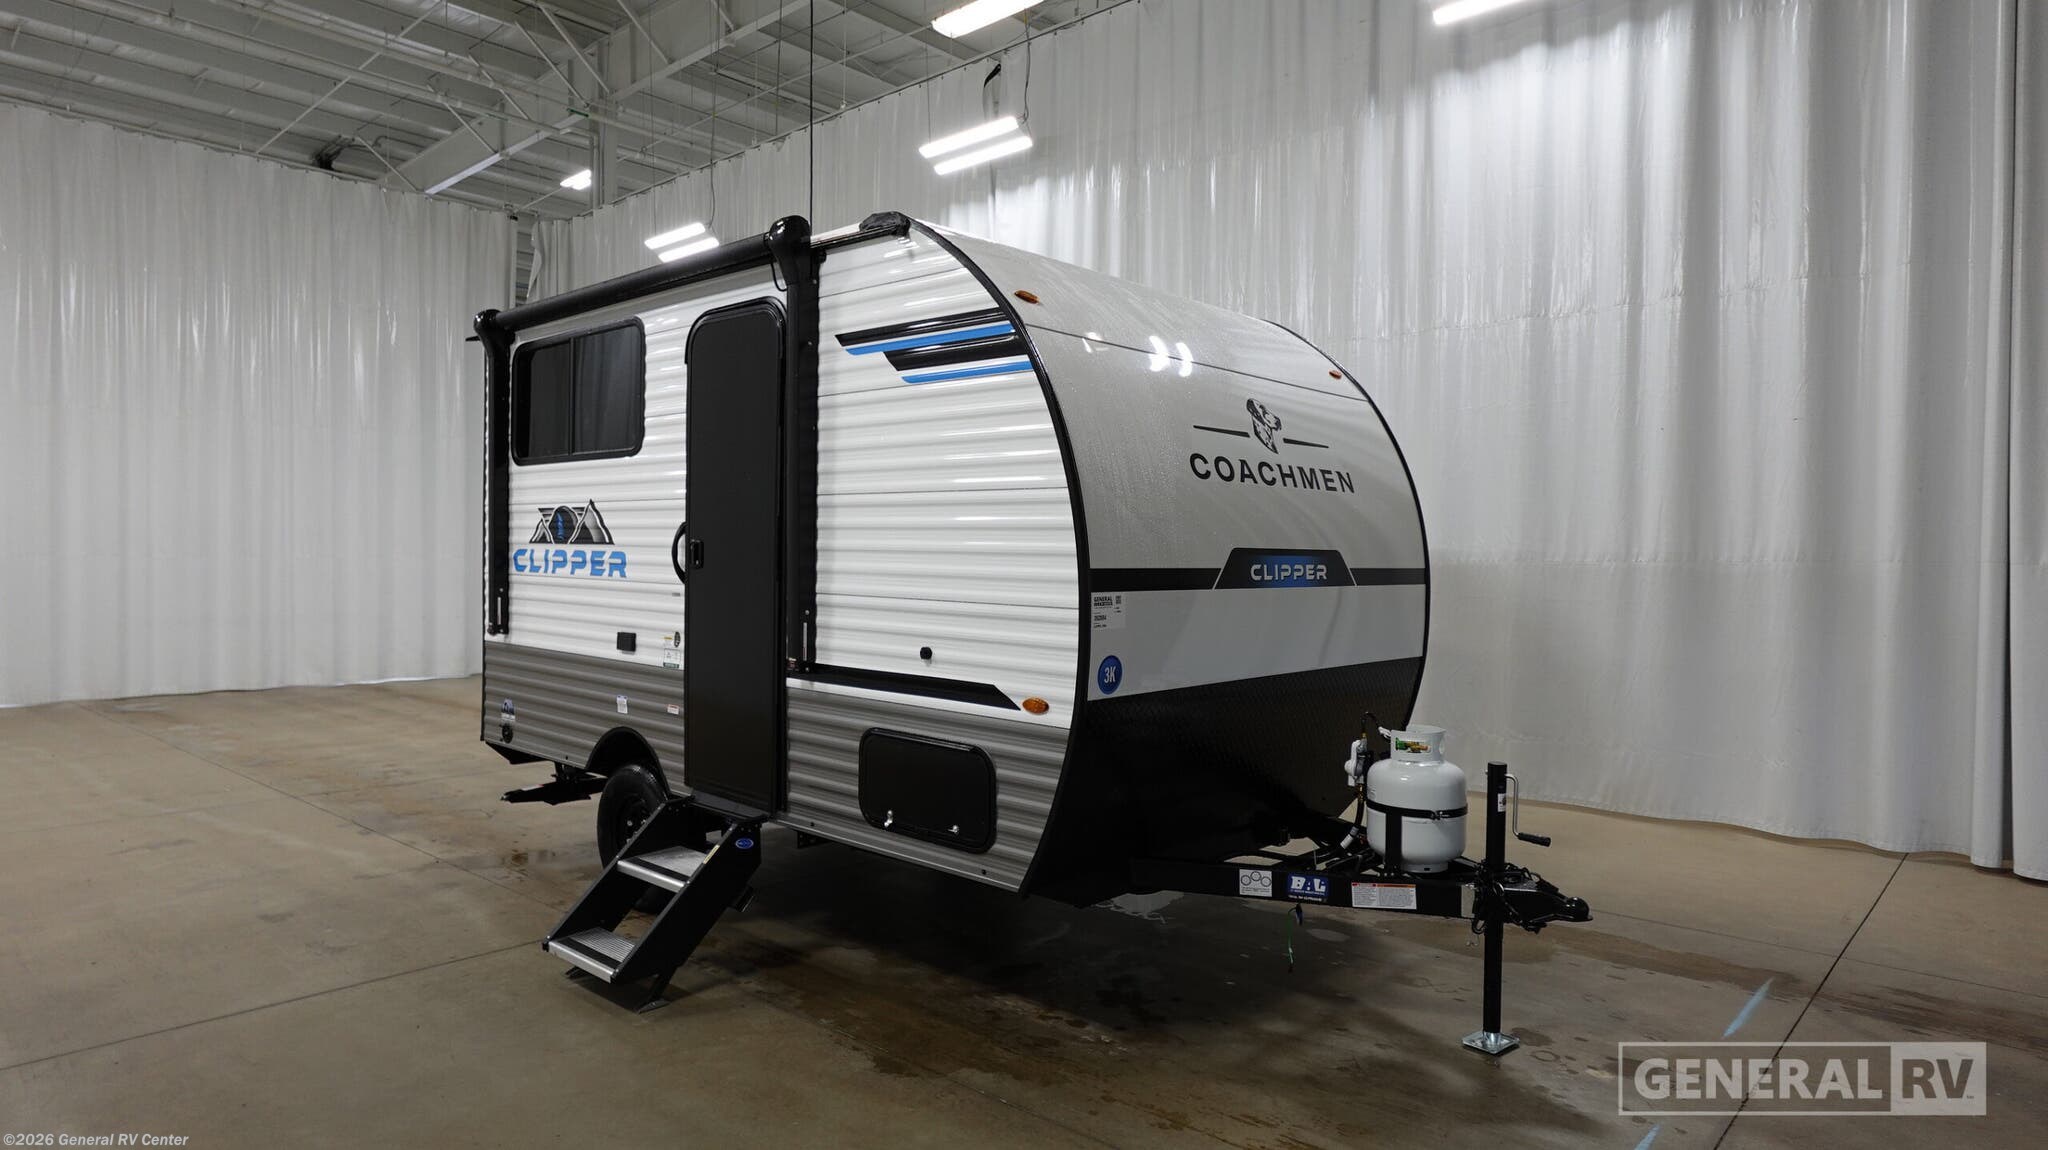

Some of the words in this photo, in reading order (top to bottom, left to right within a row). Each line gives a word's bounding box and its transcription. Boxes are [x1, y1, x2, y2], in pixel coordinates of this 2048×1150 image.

[1189, 452, 1355, 494] COACHMEN
[512, 548, 628, 578] CLIPPER
[1250, 563, 1328, 581] CLIPPER
[1103, 665, 1117, 684] 3K
